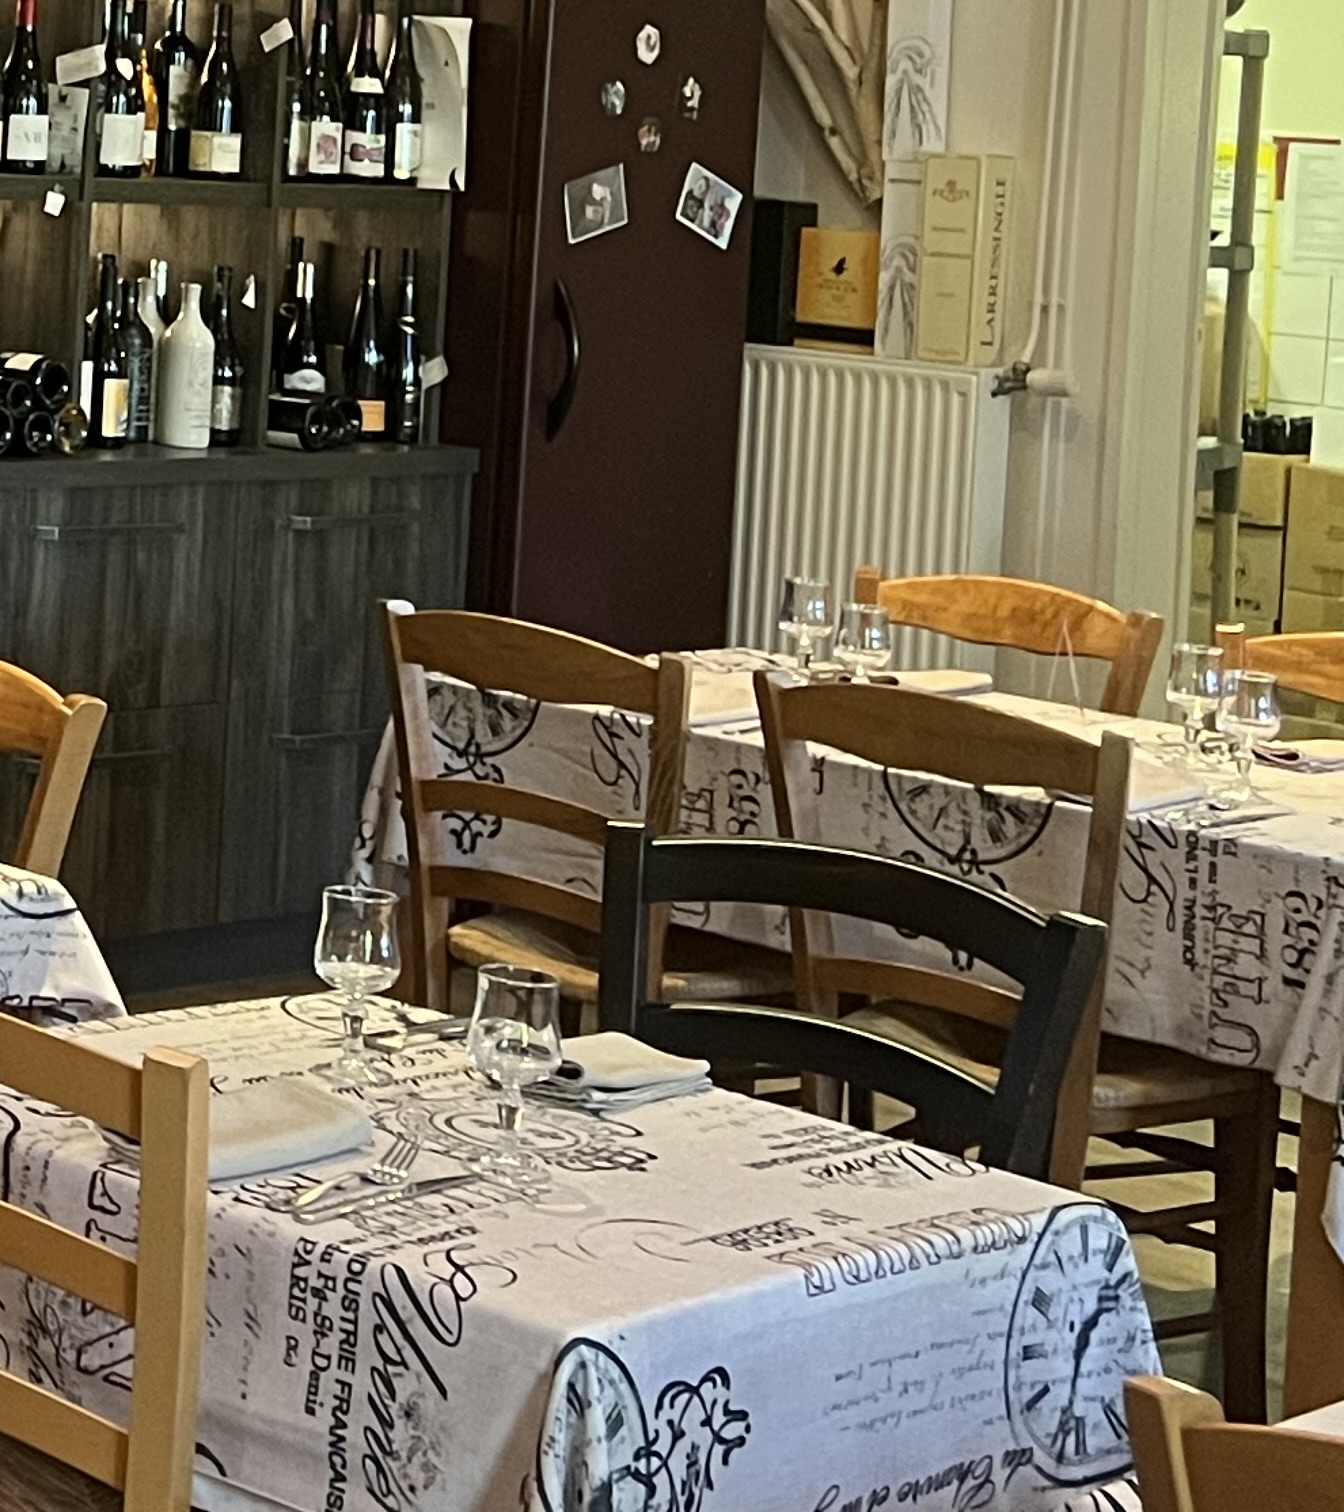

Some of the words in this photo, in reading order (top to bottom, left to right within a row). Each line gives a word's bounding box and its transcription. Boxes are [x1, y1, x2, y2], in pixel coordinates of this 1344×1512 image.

[979, 177, 1008, 347] LARRESSINGLE
[287, 1236, 318, 1325] PARIS
[323, 1378, 352, 1512] FRANCAIS
